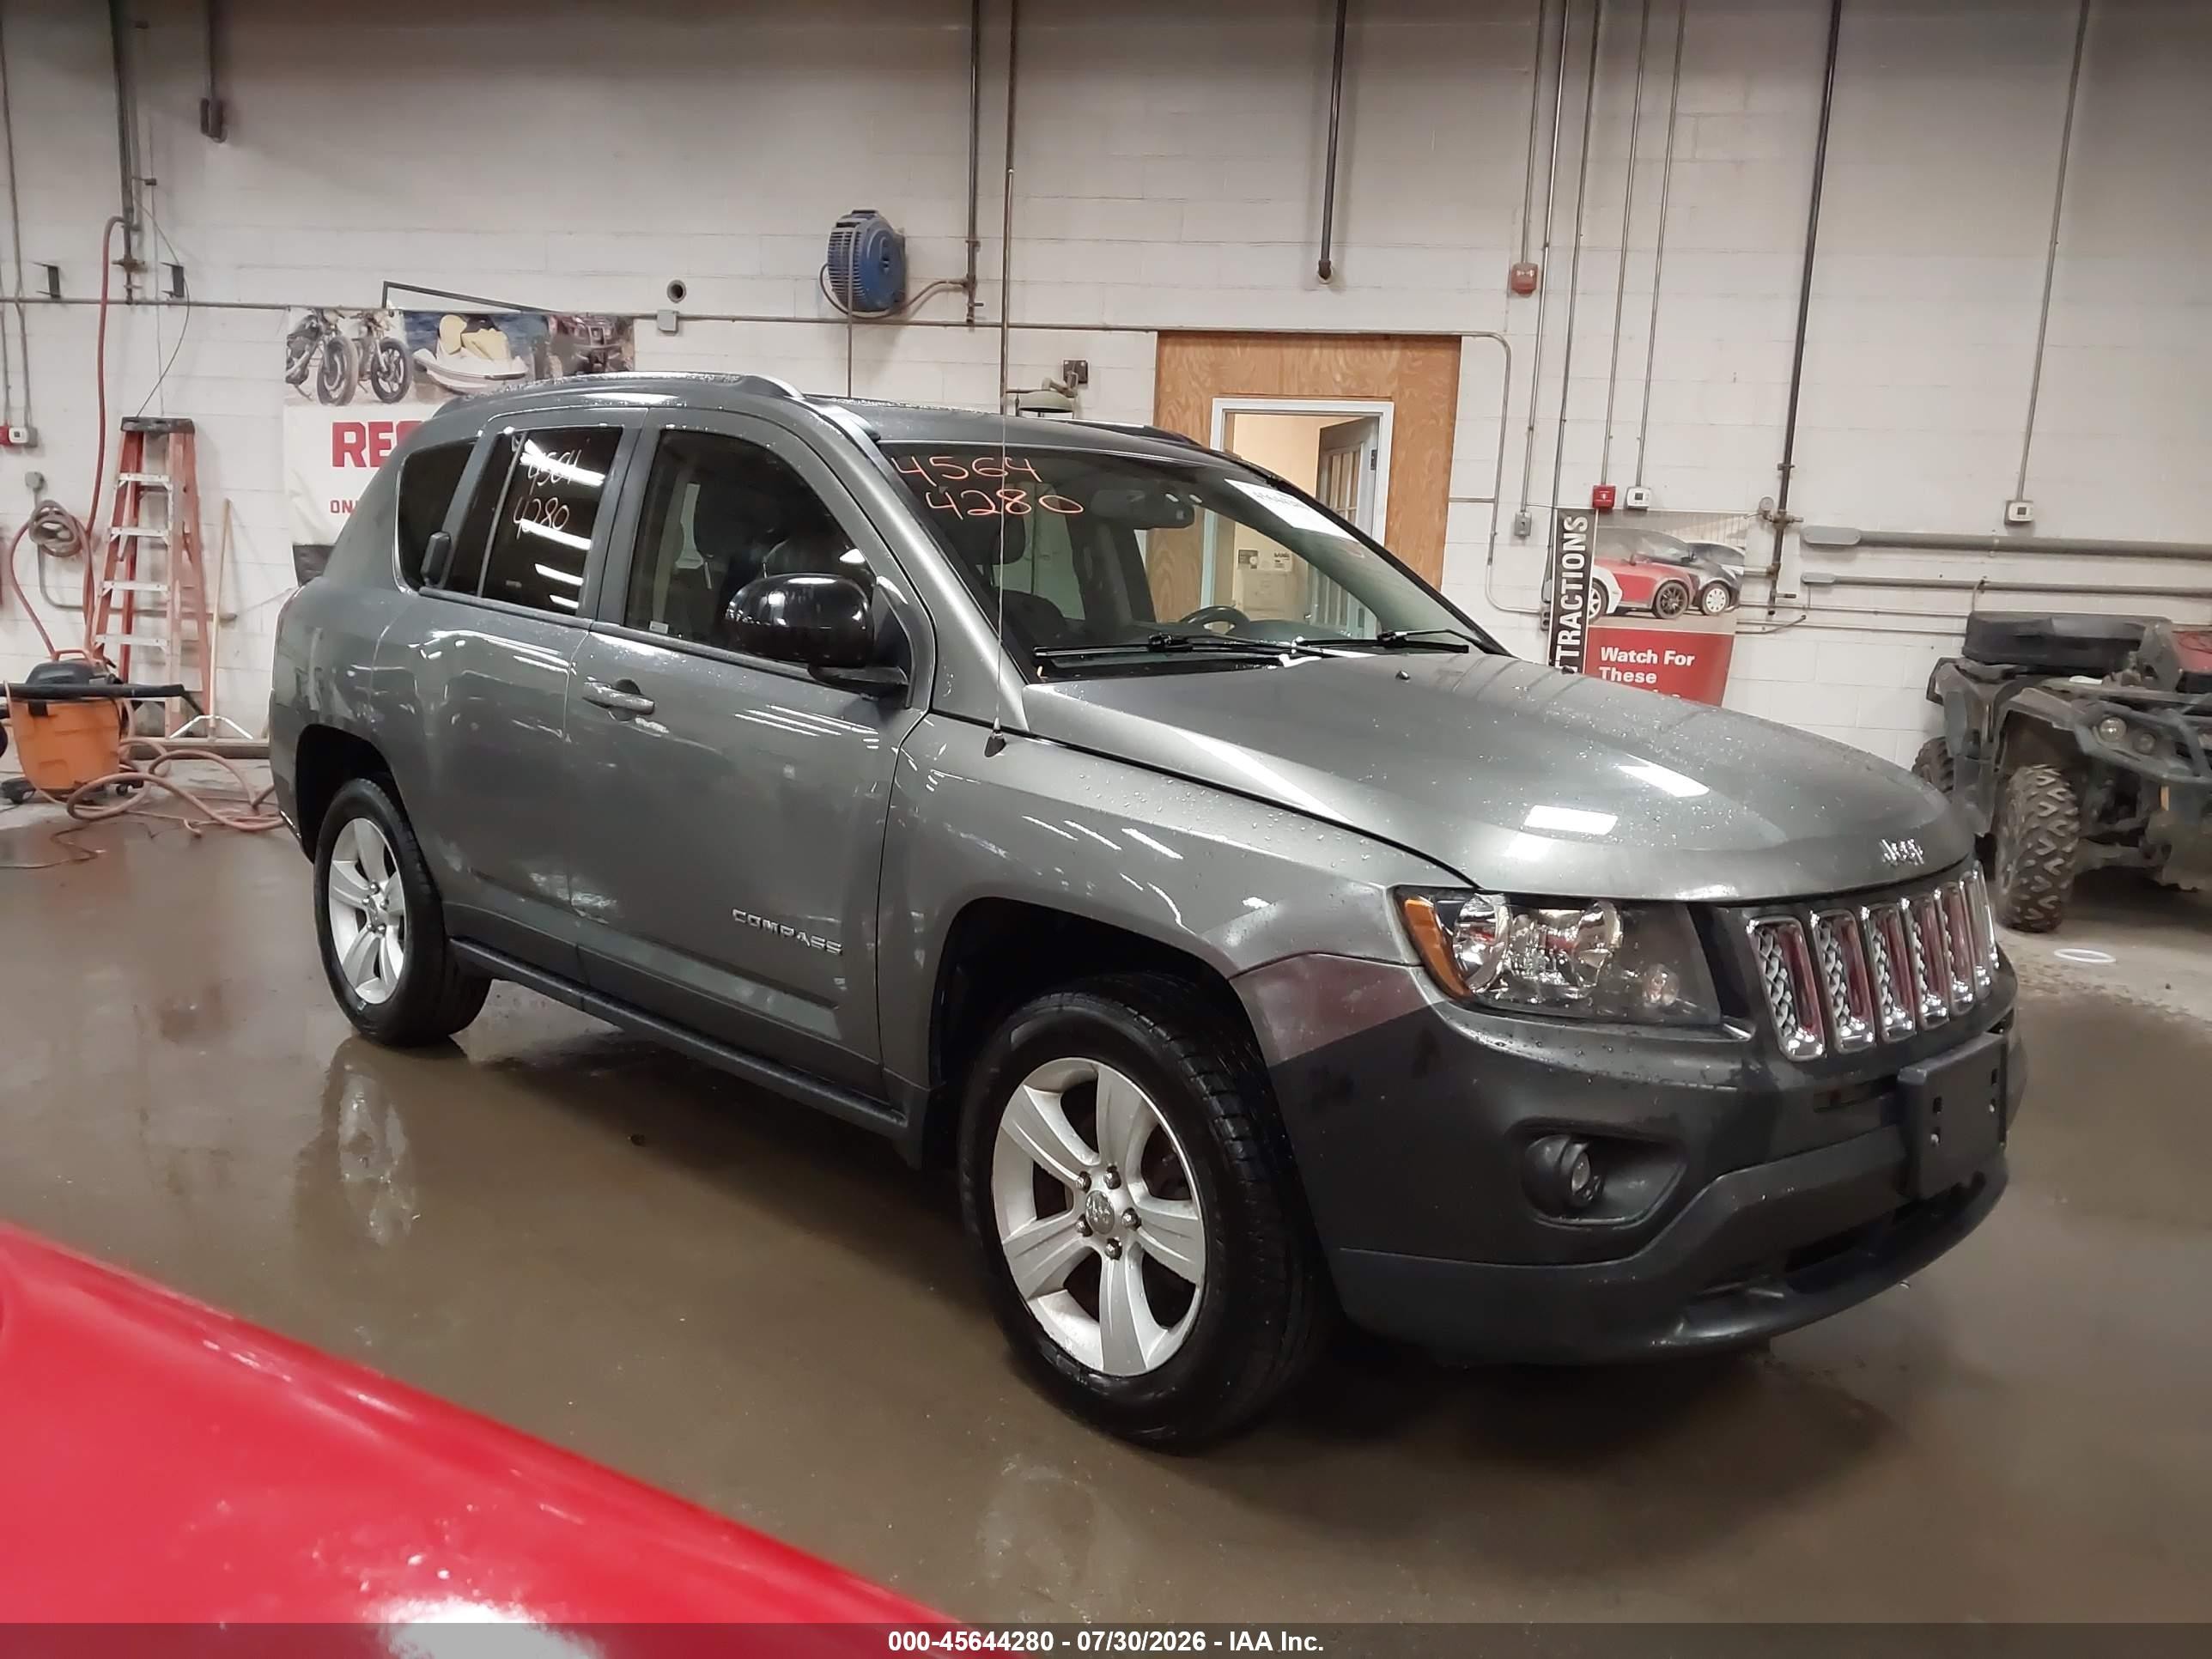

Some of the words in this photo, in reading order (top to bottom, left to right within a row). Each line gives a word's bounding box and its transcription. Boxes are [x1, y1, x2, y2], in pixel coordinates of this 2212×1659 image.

[890, 456, 1042, 487] 4564
[330, 500, 359, 514] ON
[513, 496, 570, 540] 4280
[925, 489, 1085, 520] 4280
[1601, 647, 1658, 665] Watch
[1663, 650, 1696, 666] For
[1599, 666, 1657, 684] These
[732, 908, 842, 955] COMPASS
